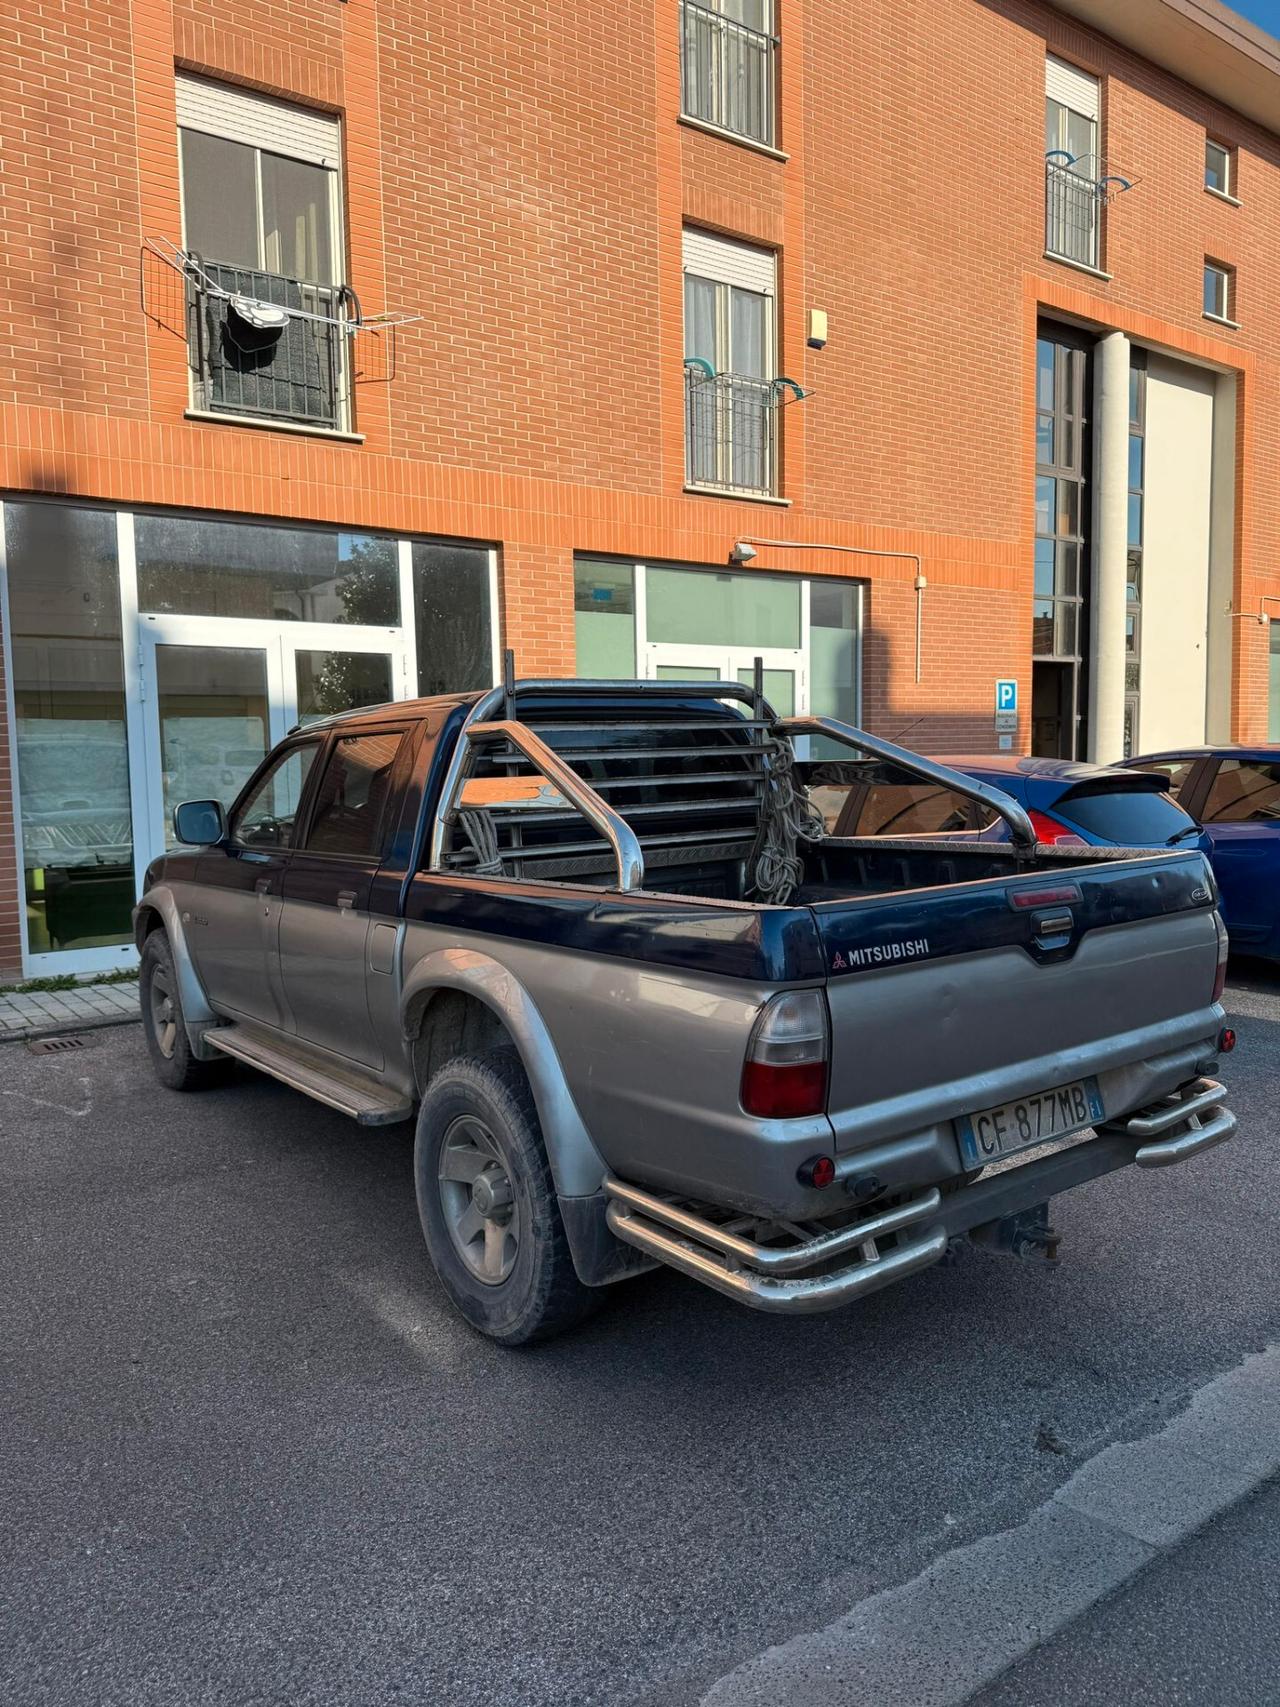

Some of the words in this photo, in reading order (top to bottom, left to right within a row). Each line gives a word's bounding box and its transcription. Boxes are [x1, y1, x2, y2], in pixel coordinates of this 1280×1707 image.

[1001, 685, 1013, 708] P
[848, 938, 929, 966] MITSUBISHI
[977, 1111, 1006, 1154] CF
